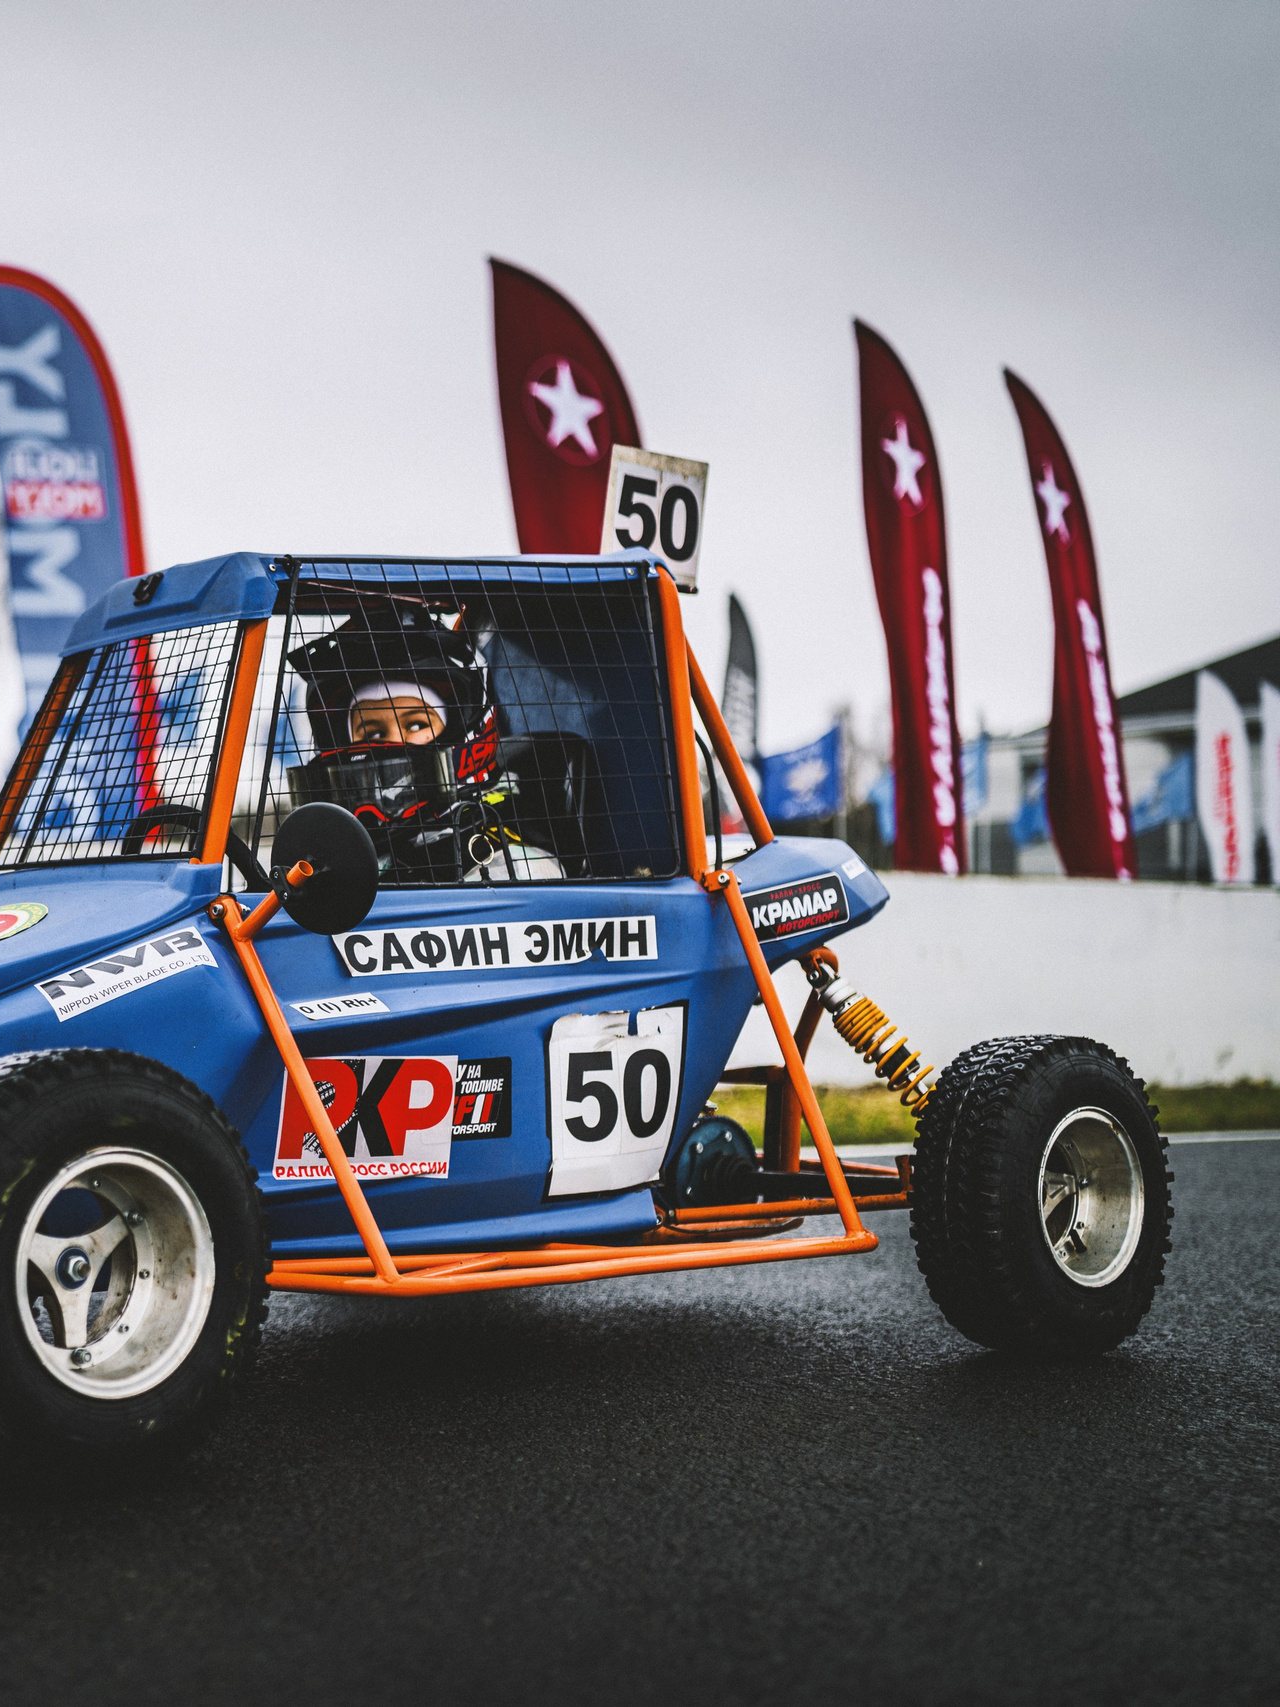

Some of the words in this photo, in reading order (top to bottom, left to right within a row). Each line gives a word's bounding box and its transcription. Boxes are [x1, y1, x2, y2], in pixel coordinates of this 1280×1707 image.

[615, 474, 699, 562] 50
[752, 888, 838, 928] КРАМАР
[776, 909, 840, 935] МОТОРСПОРТ
[344, 926, 510, 973] САФИН
[523, 920, 648, 963] ЭМИН
[39, 930, 203, 1000] NWB
[58, 993, 99, 1015] NIPPON
[99, 979, 133, 999] WIPER
[134, 965, 168, 984] BLADE
[341, 997, 378, 1009] Rh+
[460, 1078, 504, 1094] ТОПЛИВЕ
[466, 1064, 481, 1079] НА
[565, 1048, 671, 1142] 50
[451, 1123, 497, 1135] ORSPORT
[391, 1161, 448, 1176] РОССИИ
